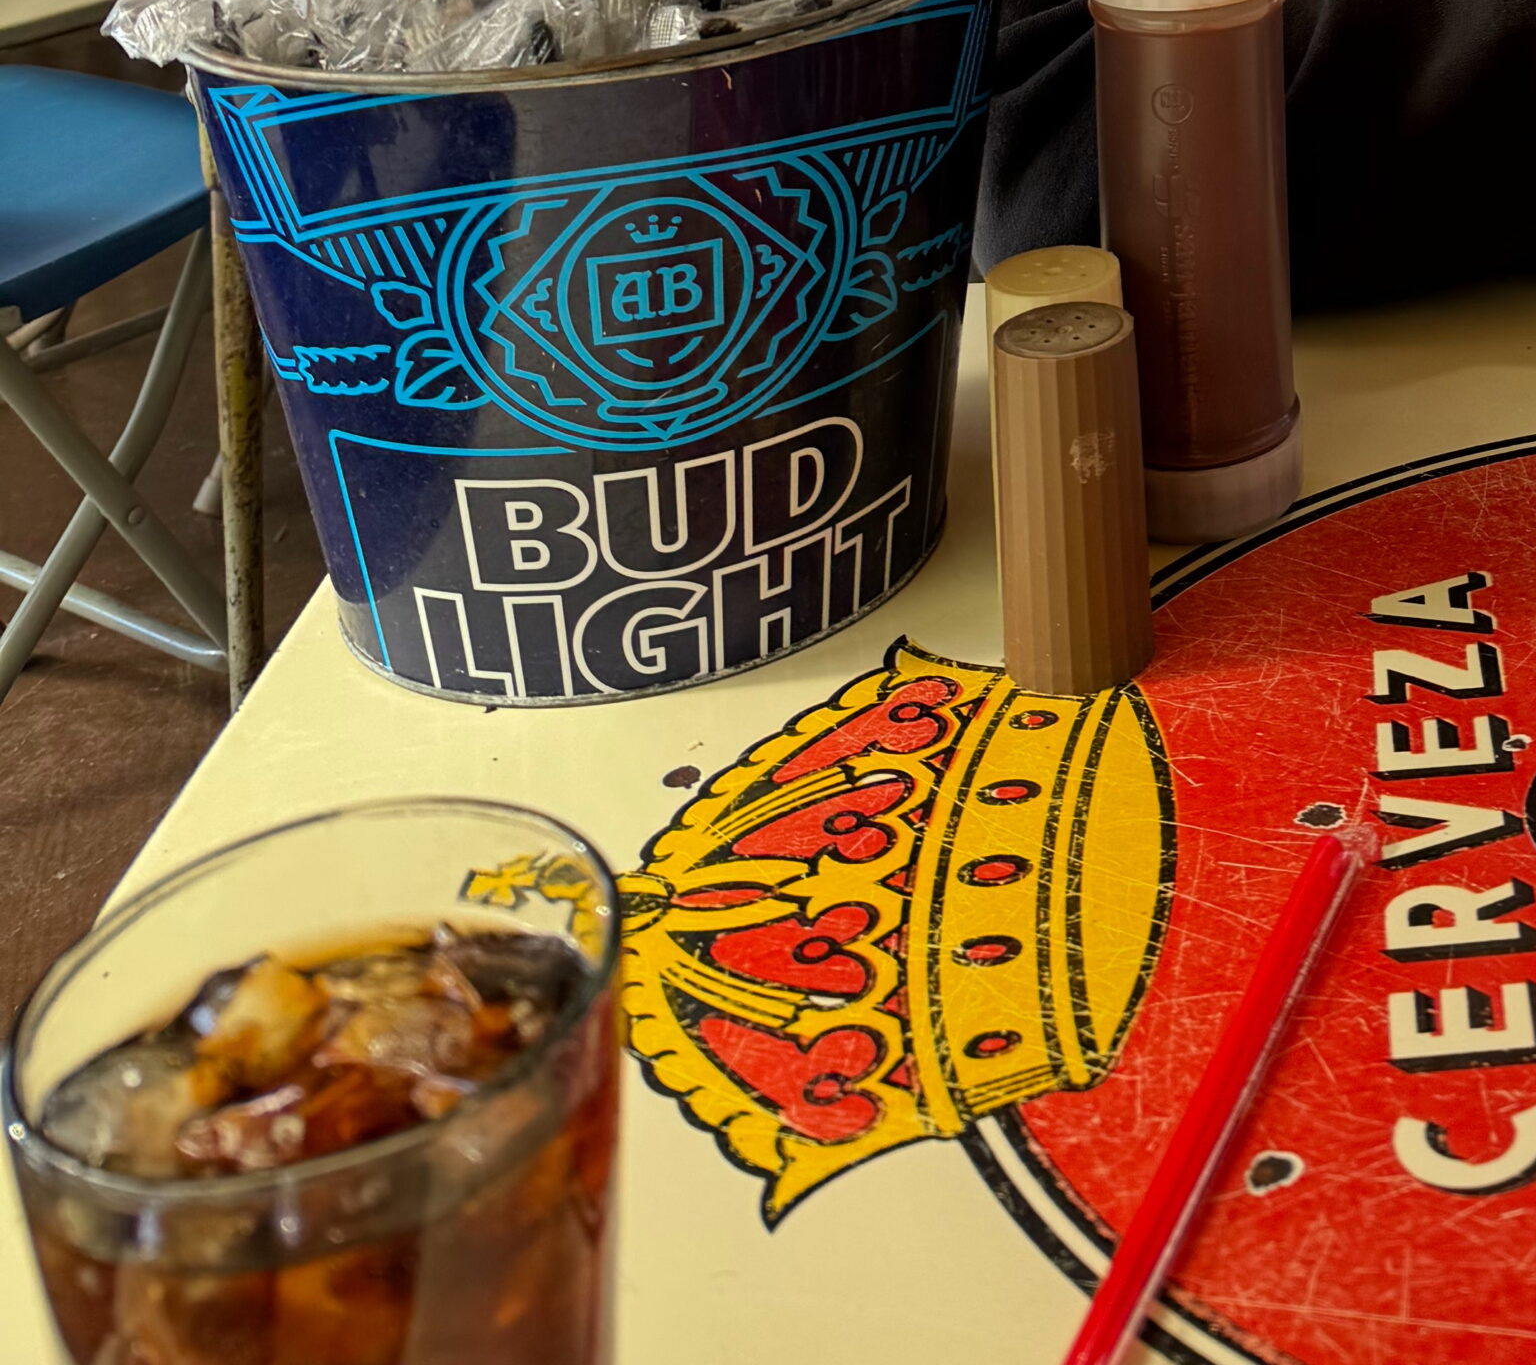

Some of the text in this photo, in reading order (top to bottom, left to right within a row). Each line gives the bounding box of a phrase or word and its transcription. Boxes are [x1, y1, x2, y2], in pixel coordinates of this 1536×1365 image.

[607, 260, 705, 323] AB
[413, 473, 913, 699] LIGHT
[455, 416, 865, 593] BUD
